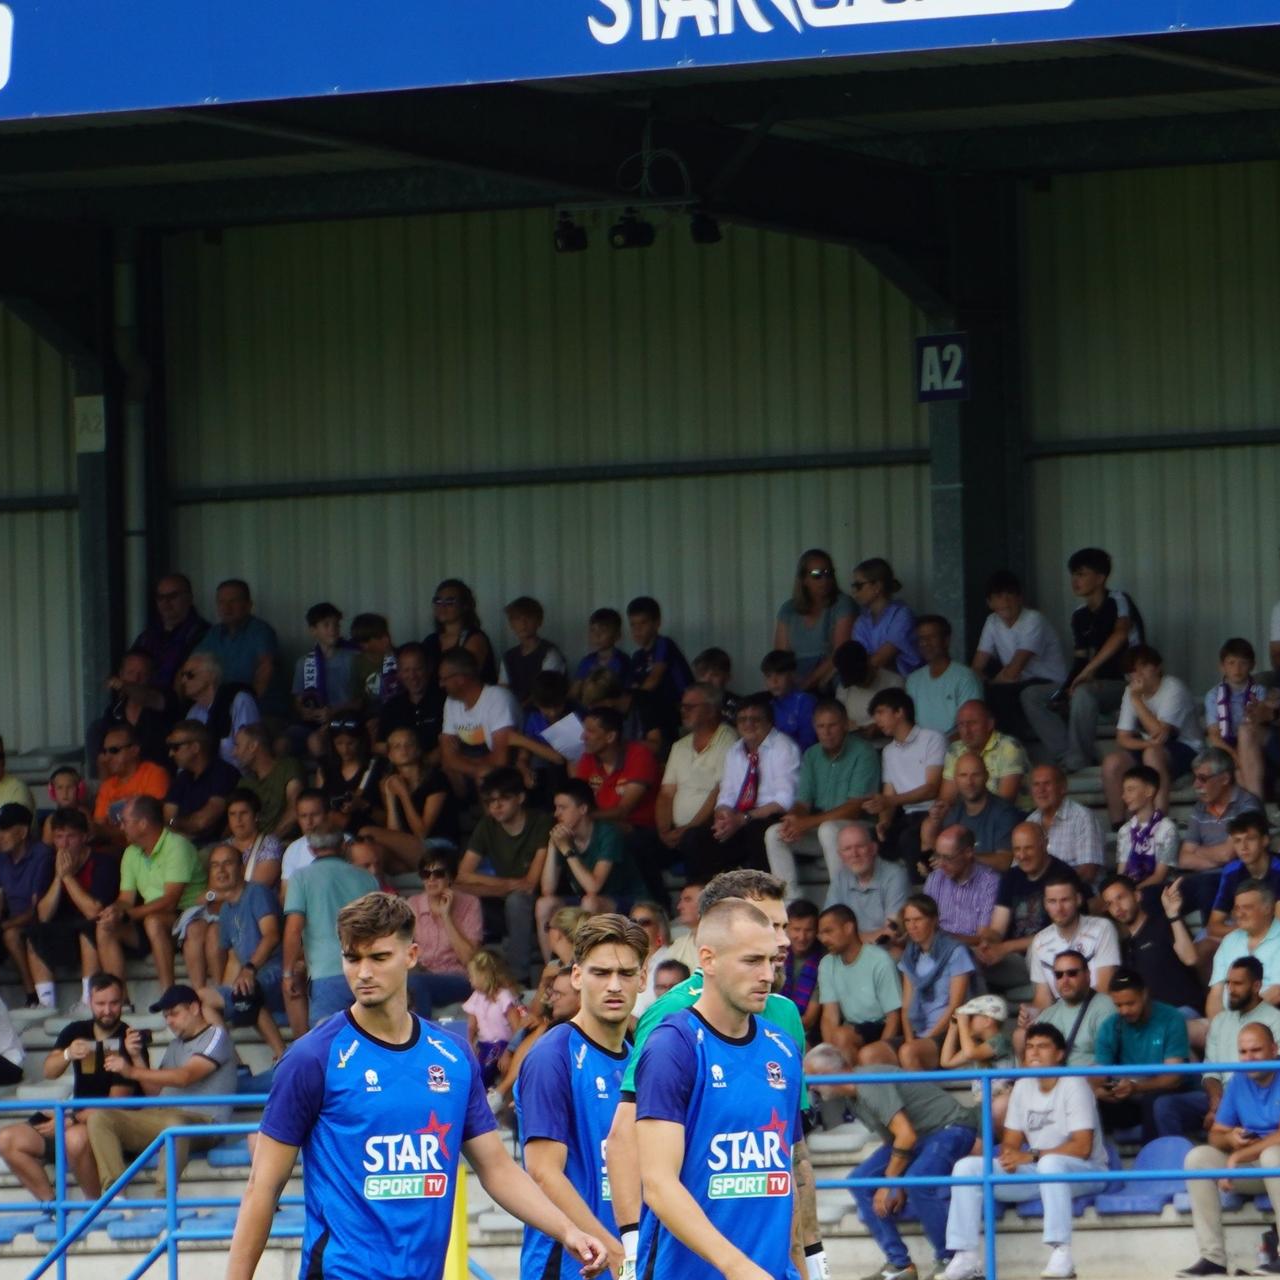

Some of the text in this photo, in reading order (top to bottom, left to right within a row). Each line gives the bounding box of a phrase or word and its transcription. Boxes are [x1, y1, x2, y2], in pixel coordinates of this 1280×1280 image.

[921, 344, 963, 392] A2
[363, 1133, 443, 1172] STAR
[708, 1131, 786, 1171] STAR
[367, 1177, 443, 1196] SPORT TV
[712, 1176, 786, 1195] SPORT TV
